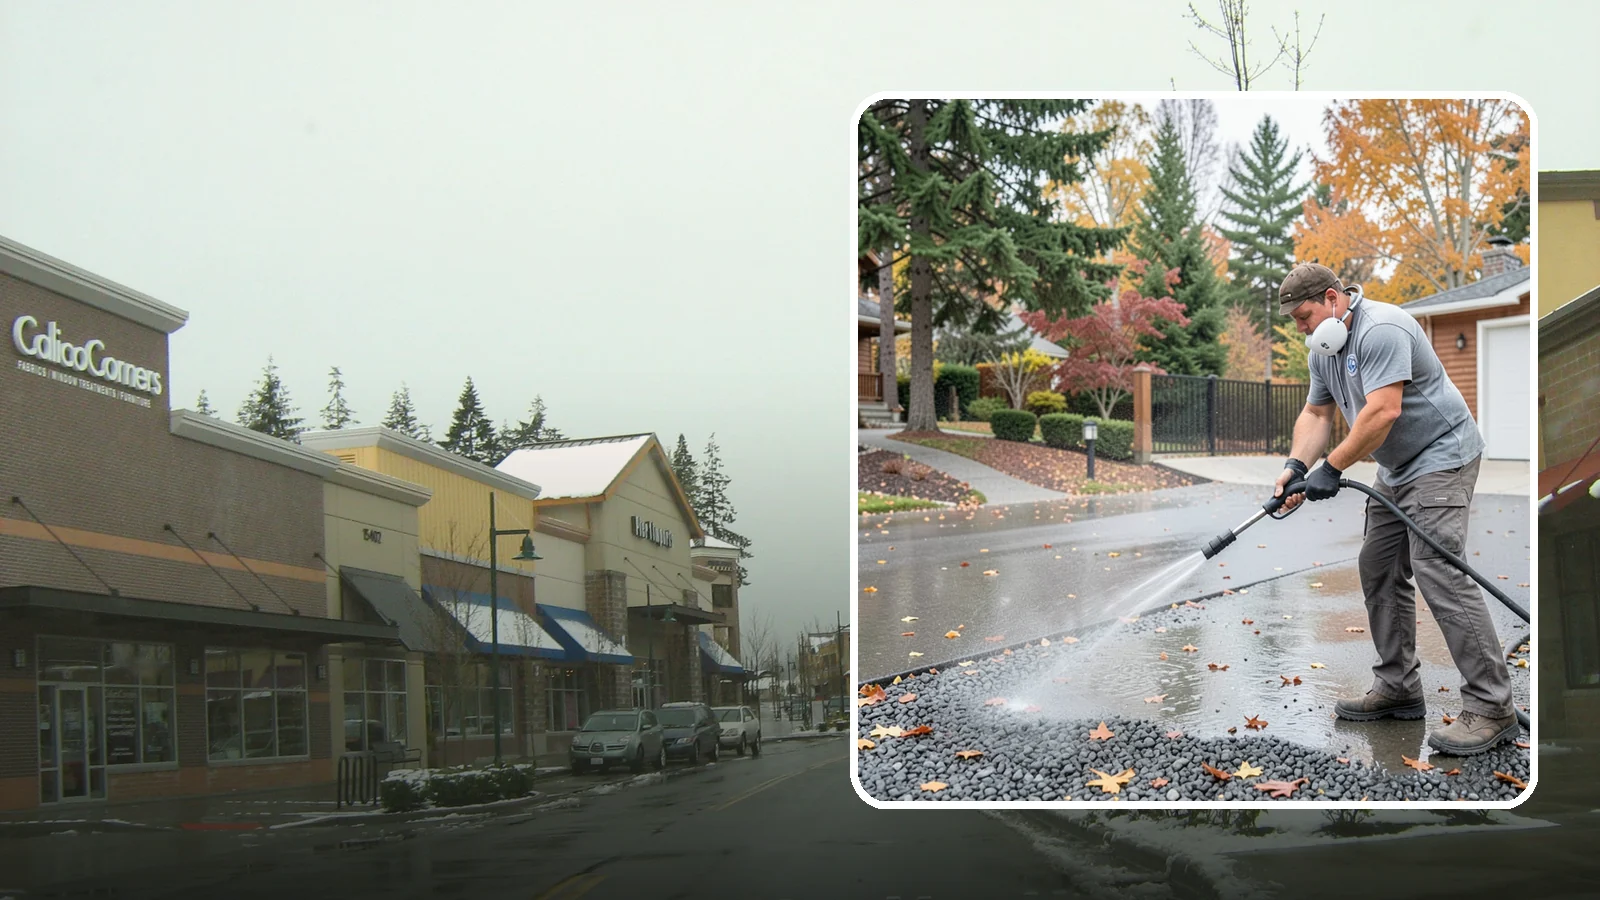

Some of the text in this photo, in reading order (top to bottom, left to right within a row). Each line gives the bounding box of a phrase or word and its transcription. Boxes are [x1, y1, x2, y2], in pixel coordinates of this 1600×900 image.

[16, 360, 151, 408] FABRICS WINDOW TREATMENTS FURNITURE
